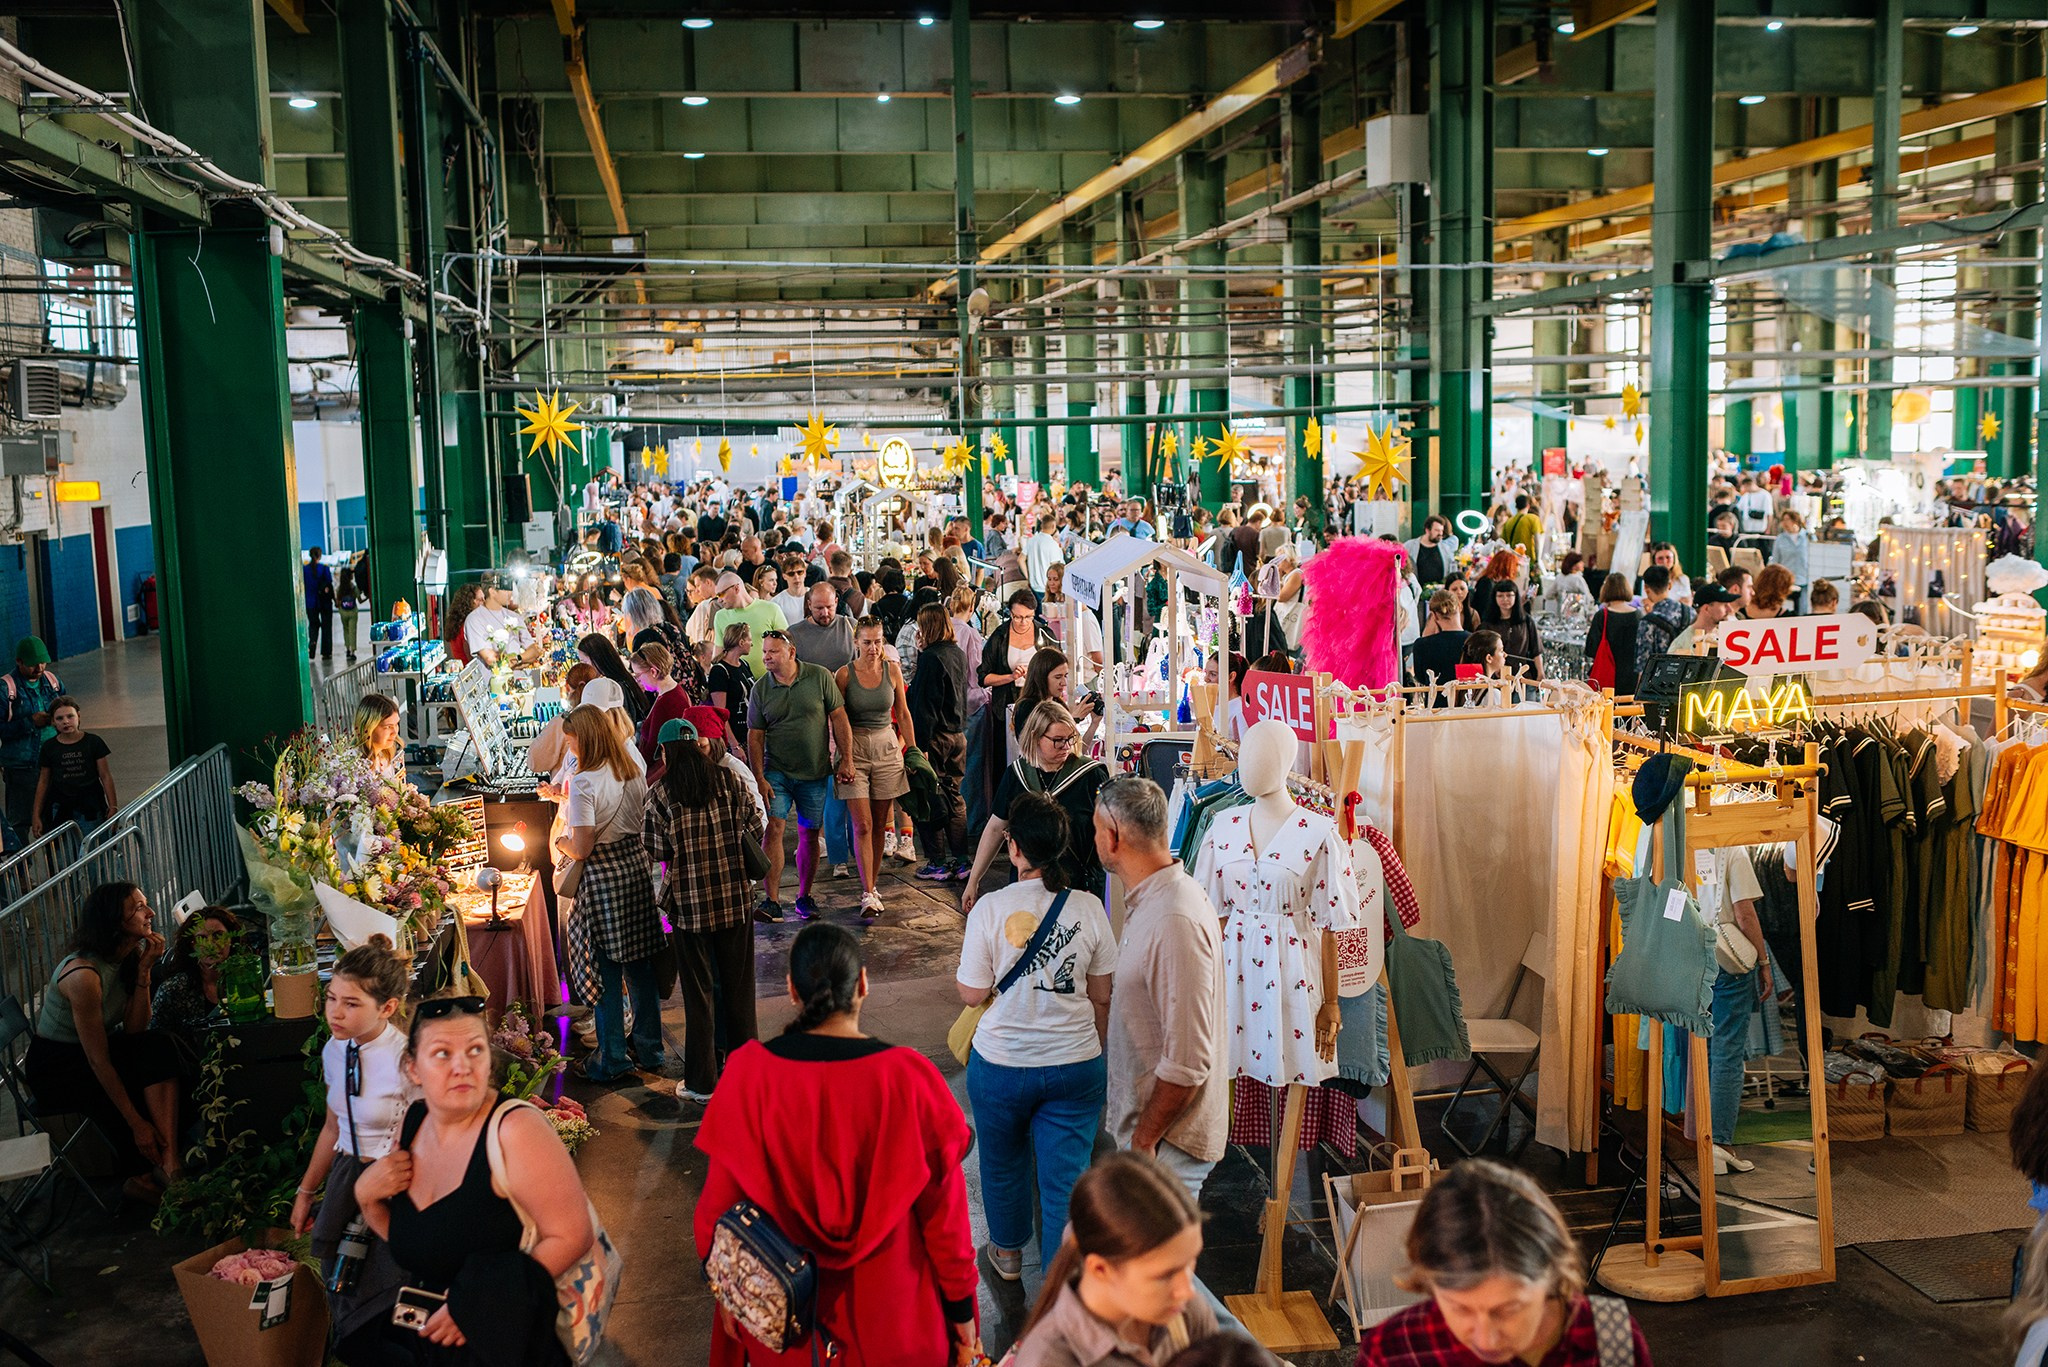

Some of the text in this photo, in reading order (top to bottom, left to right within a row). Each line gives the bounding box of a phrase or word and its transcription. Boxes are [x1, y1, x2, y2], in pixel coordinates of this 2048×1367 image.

[1724, 625, 1840, 666] SALE
[1256, 681, 1313, 731] SALE
[1685, 682, 1811, 732] MAYA
[62, 751, 83, 760] GIRLS
